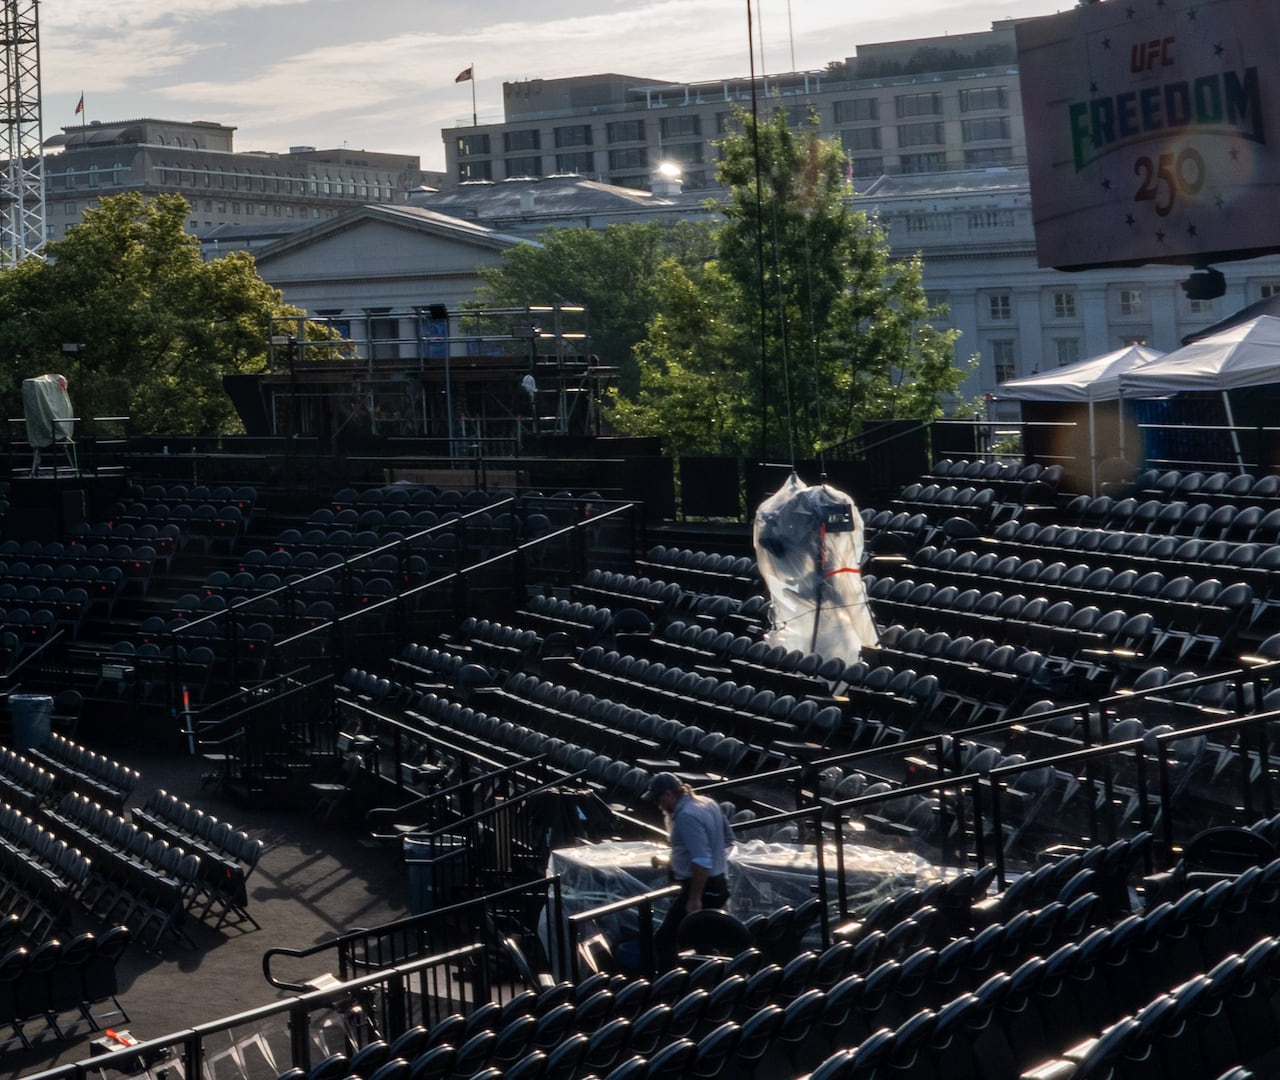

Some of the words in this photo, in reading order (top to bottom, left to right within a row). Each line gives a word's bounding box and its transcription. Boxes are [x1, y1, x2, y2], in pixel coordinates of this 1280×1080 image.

[1130, 36, 1175, 74] UFC
[1069, 67, 1266, 174] FREEDOM
[1133, 148, 1205, 217] 250
